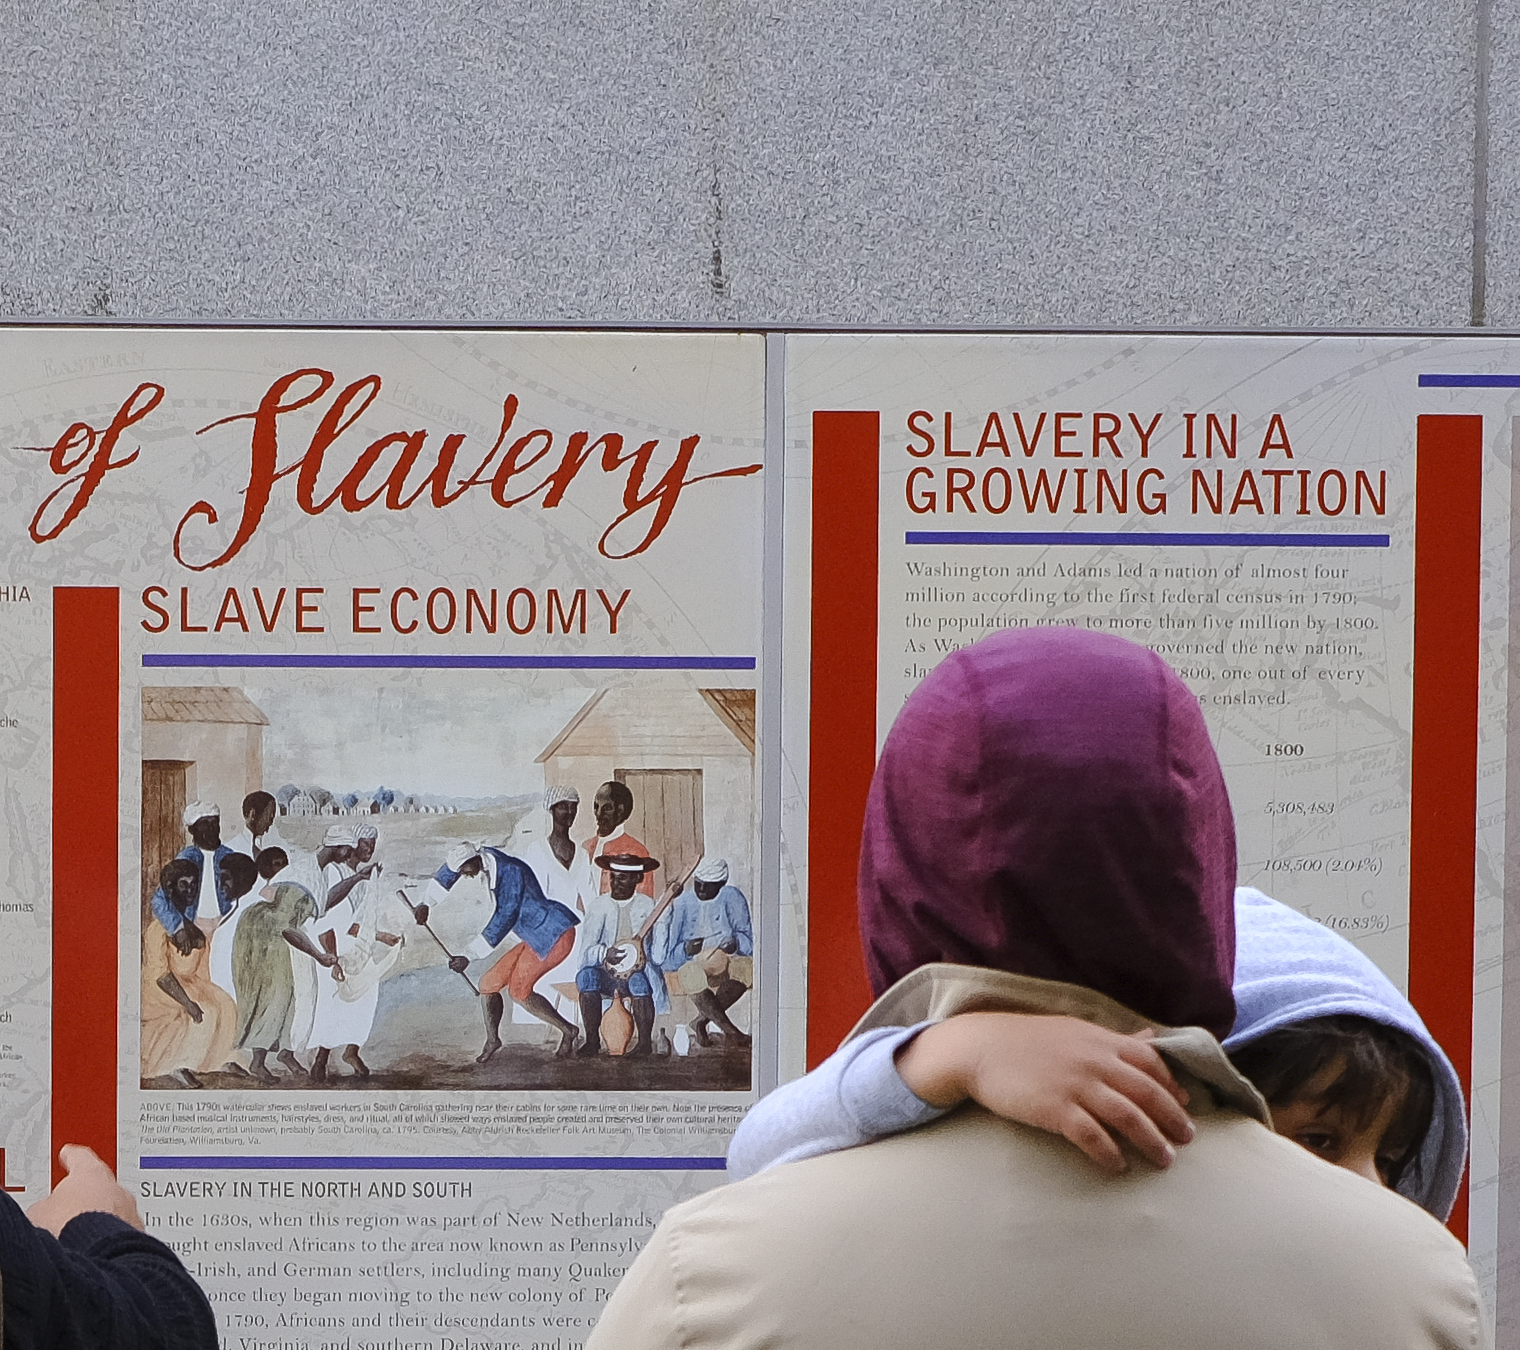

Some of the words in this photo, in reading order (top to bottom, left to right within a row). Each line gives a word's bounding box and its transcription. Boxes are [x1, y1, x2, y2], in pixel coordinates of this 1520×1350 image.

[907, 410, 1162, 460] SLAVERY
[1183, 412, 1238, 460] IN
[1259, 413, 1295, 460] A
[12, 382, 167, 544] of
[173, 367, 765, 571] Slavery
[905, 466, 1167, 516] GROWING
[1191, 467, 1387, 516] NATION
[905, 561, 1009, 582] Washington
[1016, 561, 1046, 577] and
[1053, 560, 1111, 578] Adams
[1118, 562, 1143, 578] led
[1149, 567, 1158, 579] a
[1164, 563, 1218, 579] nation
[1224, 561, 1244, 579] of
[1250, 563, 1308, 579] almost
[1314, 563, 1350, 579] four
[140, 585, 326, 634] SLAVE
[352, 586, 631, 636] ECONOMY
[1265, 743, 1305, 757] 1800
[1263, 855, 1323, 873] 108,500
[140, 1180, 227, 1198] SLAVERY
[232, 1181, 252, 1198] IN
[257, 1181, 295, 1199] THE
[301, 1181, 361, 1199] NORTH
[367, 1180, 407, 1198] AND
[412, 1181, 472, 1199] SOUTH
